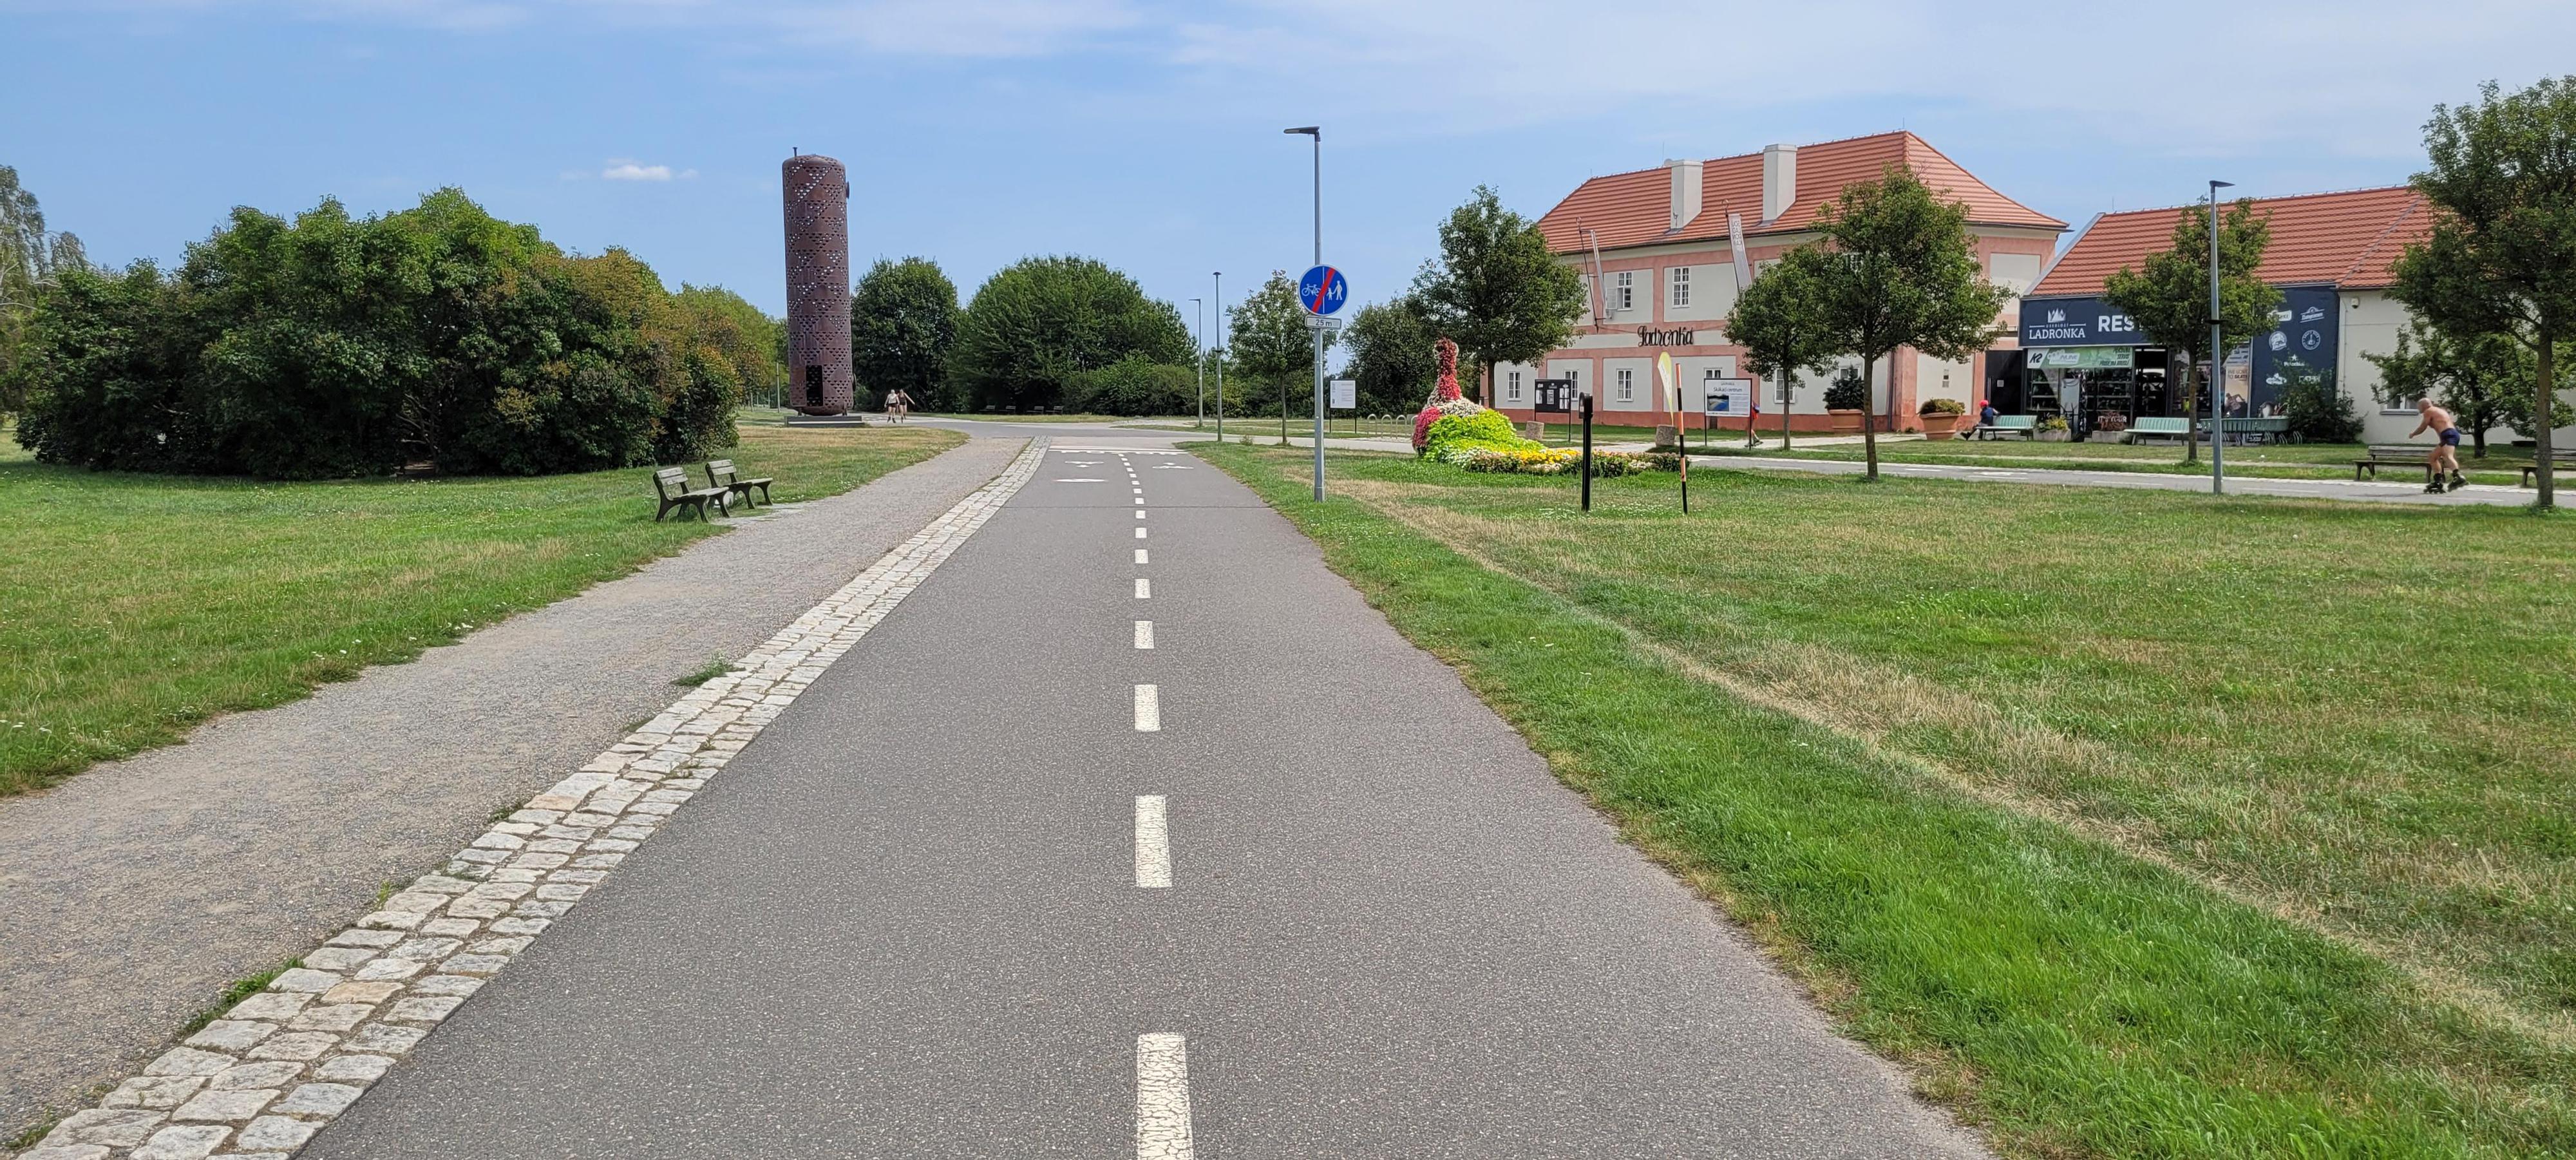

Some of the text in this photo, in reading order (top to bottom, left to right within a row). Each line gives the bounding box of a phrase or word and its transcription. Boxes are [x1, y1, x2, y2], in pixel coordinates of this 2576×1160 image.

[2098, 314, 2139, 332] RES
[1638, 325, 1694, 347] Ladronka
[2029, 328, 2086, 339] LADRONKA
